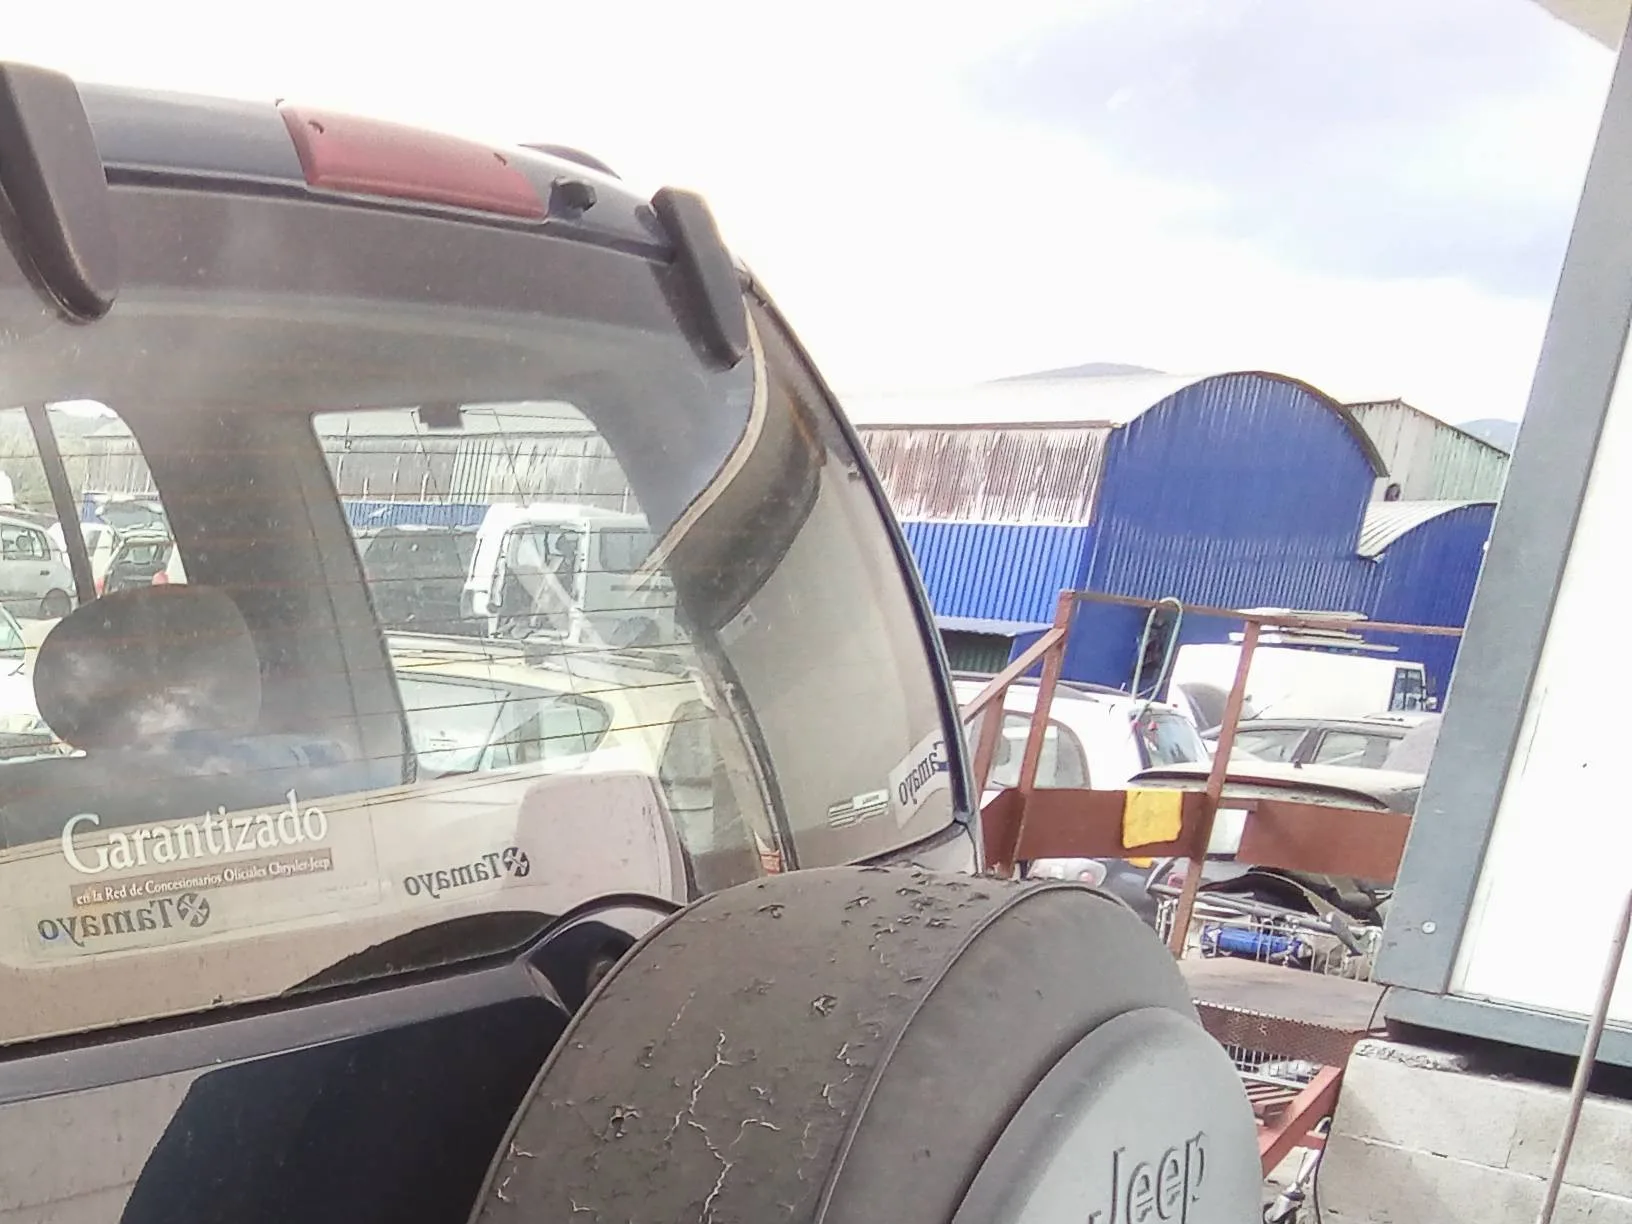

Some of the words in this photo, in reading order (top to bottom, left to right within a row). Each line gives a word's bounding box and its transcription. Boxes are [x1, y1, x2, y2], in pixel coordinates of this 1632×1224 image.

[61, 788, 329, 875] Garantizado
[105, 884, 128, 901] Red
[130, 882, 144, 896] de
[145, 872, 223, 894] Concesionarios
